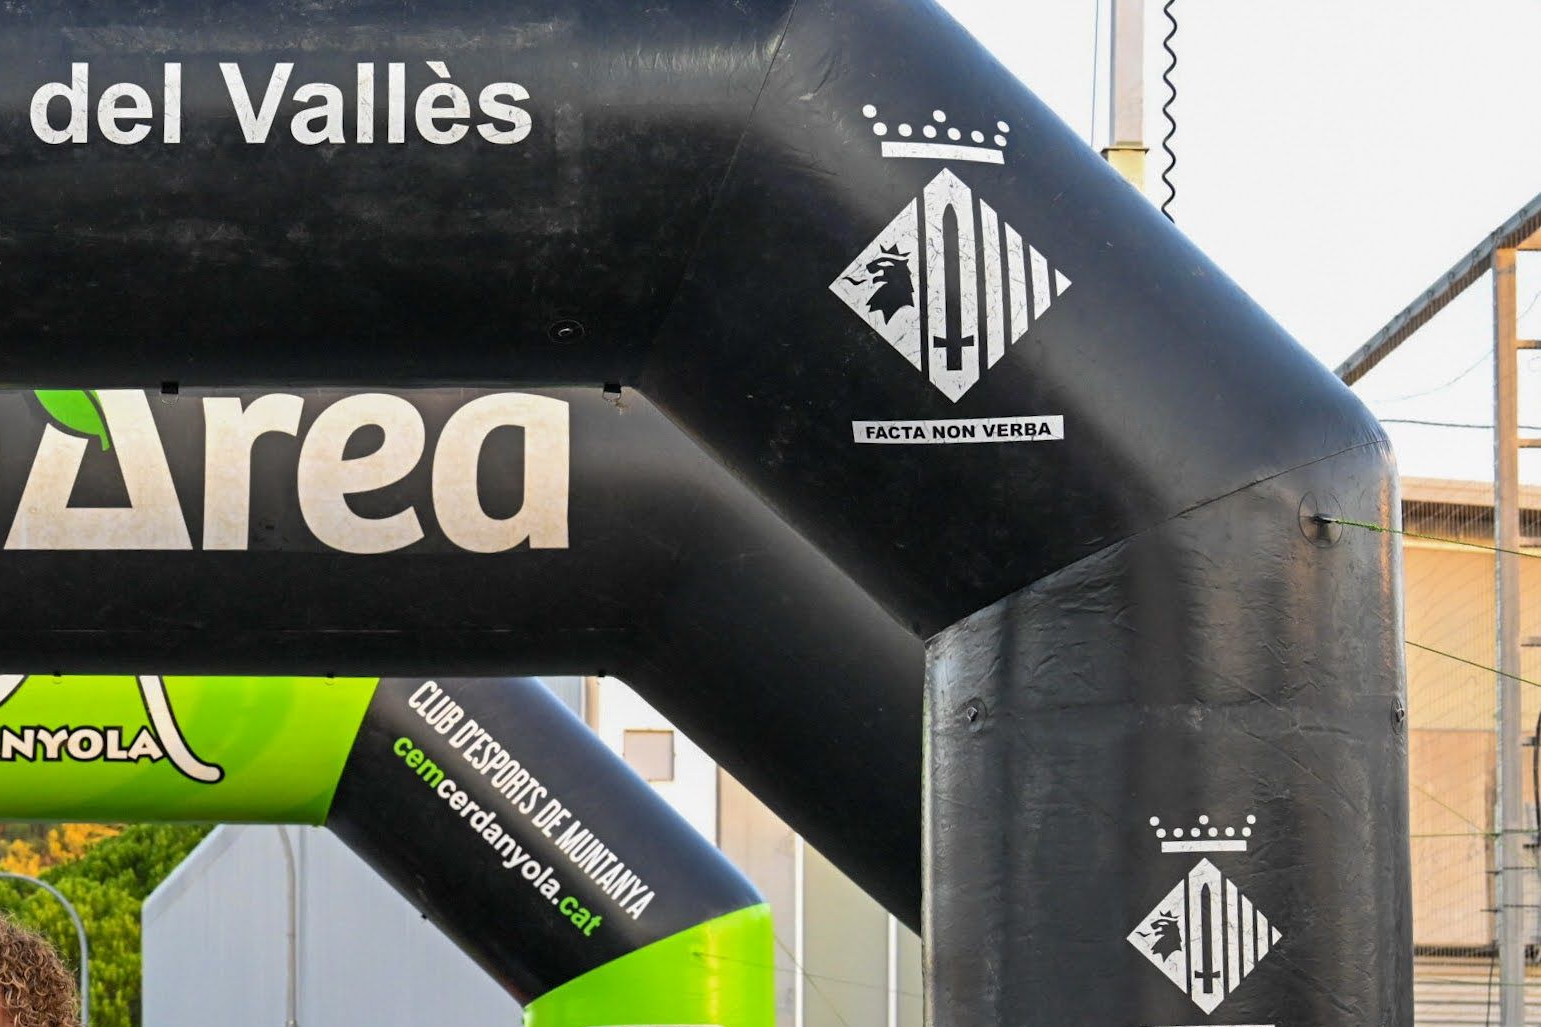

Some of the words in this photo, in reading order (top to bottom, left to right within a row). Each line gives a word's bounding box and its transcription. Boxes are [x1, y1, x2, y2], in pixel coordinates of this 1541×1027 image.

[29, 62, 182, 145] del
[218, 61, 532, 145] Vallès
[865, 426, 926, 440] FACTA
[932, 424, 976, 439] NON
[982, 422, 1052, 438] VERBA
[393, 736, 603, 937] cemcerdanyola.cat
[407, 680, 464, 735] CLUB
[448, 719, 548, 815] D'ESPORTS
[530, 797, 572, 839] DE
[554, 820, 656, 920] MUNTANYA
